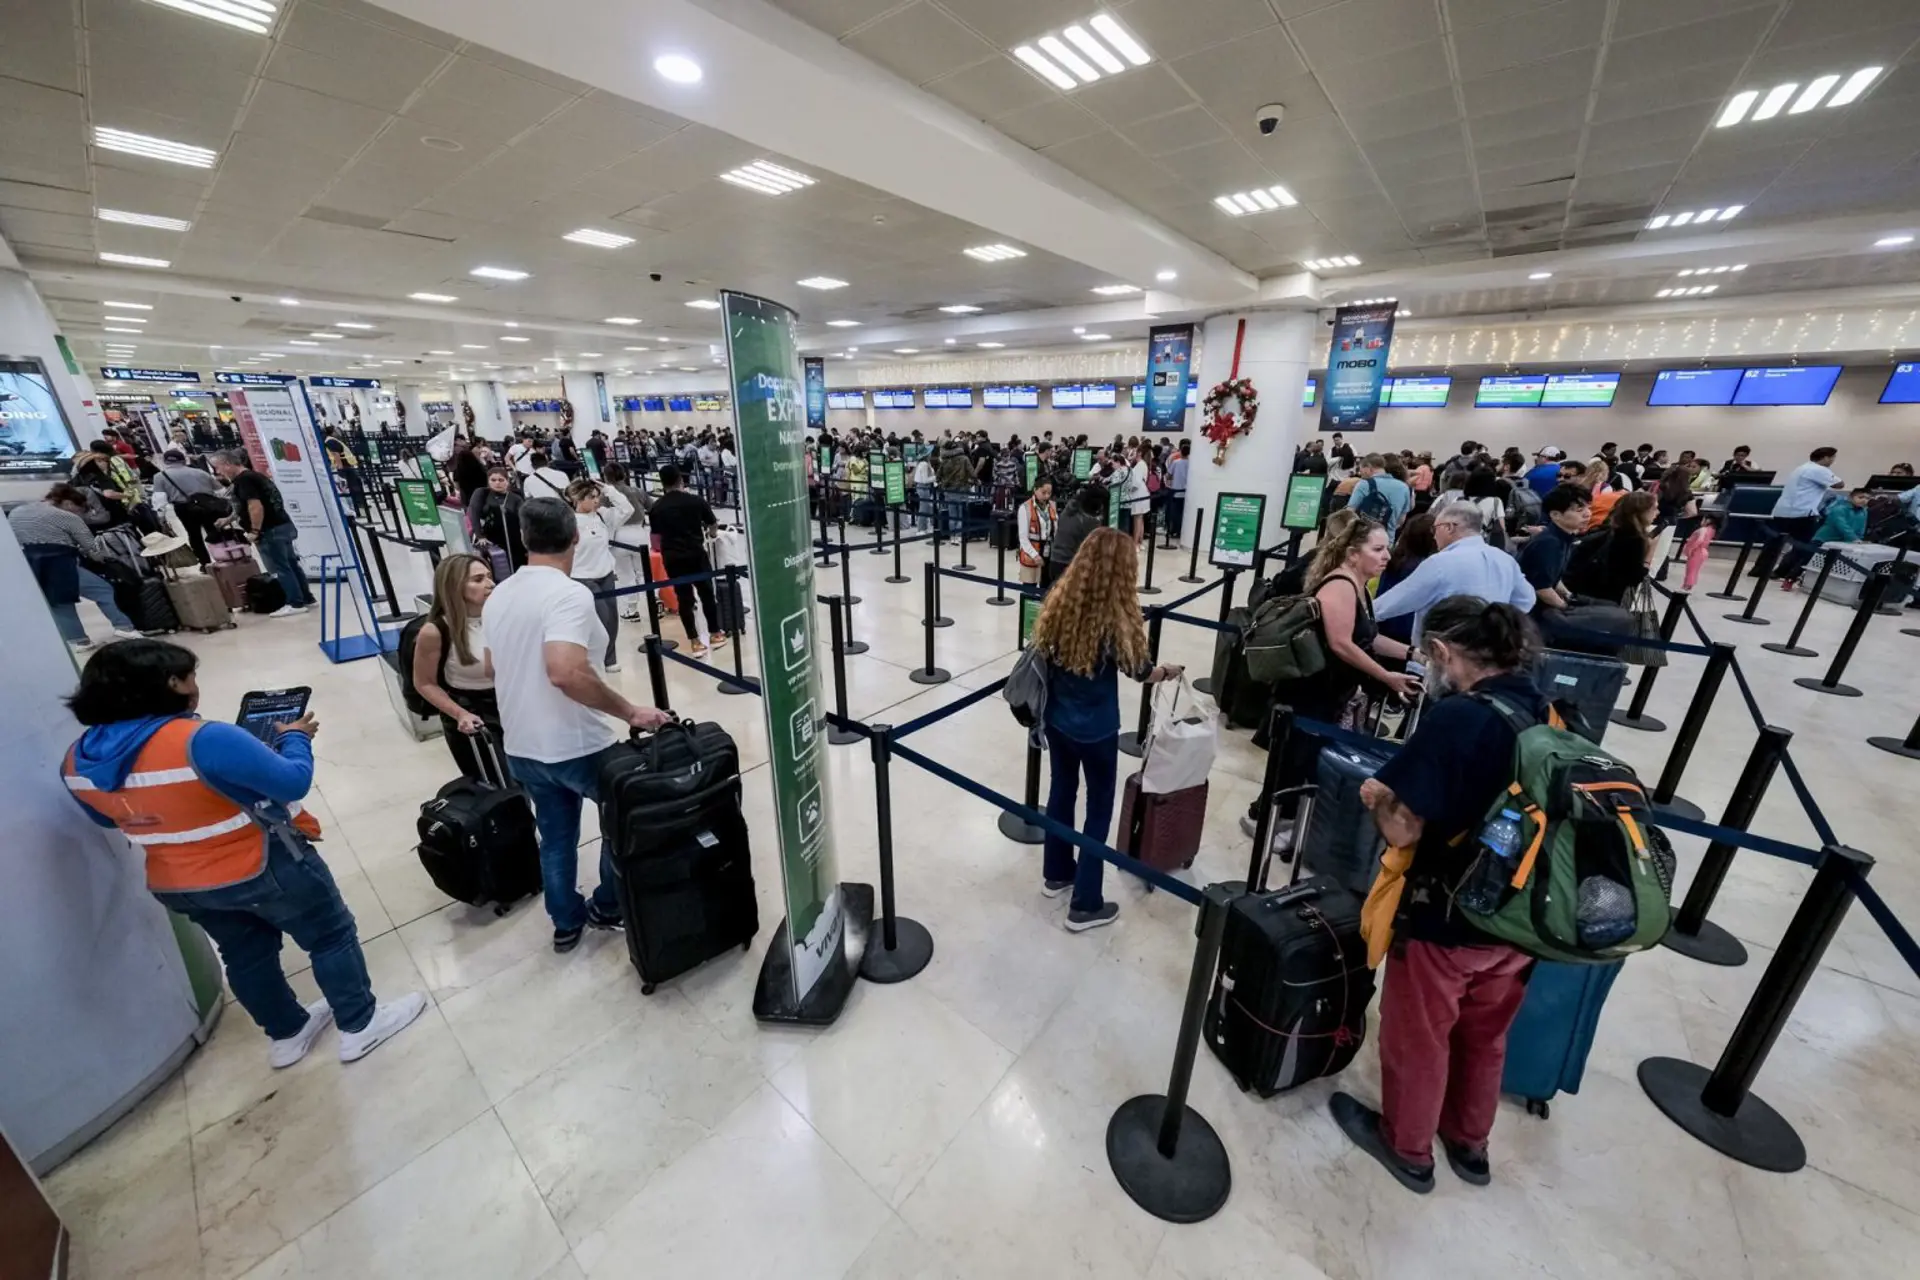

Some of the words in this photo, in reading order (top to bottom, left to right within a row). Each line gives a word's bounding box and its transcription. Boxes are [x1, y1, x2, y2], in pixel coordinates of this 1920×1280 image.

[1336, 359, 1377, 370] MOBO
[1896, 364, 1913, 373] 63
[1658, 372, 1671, 380] 61
[1745, 370, 1760, 378] 62
